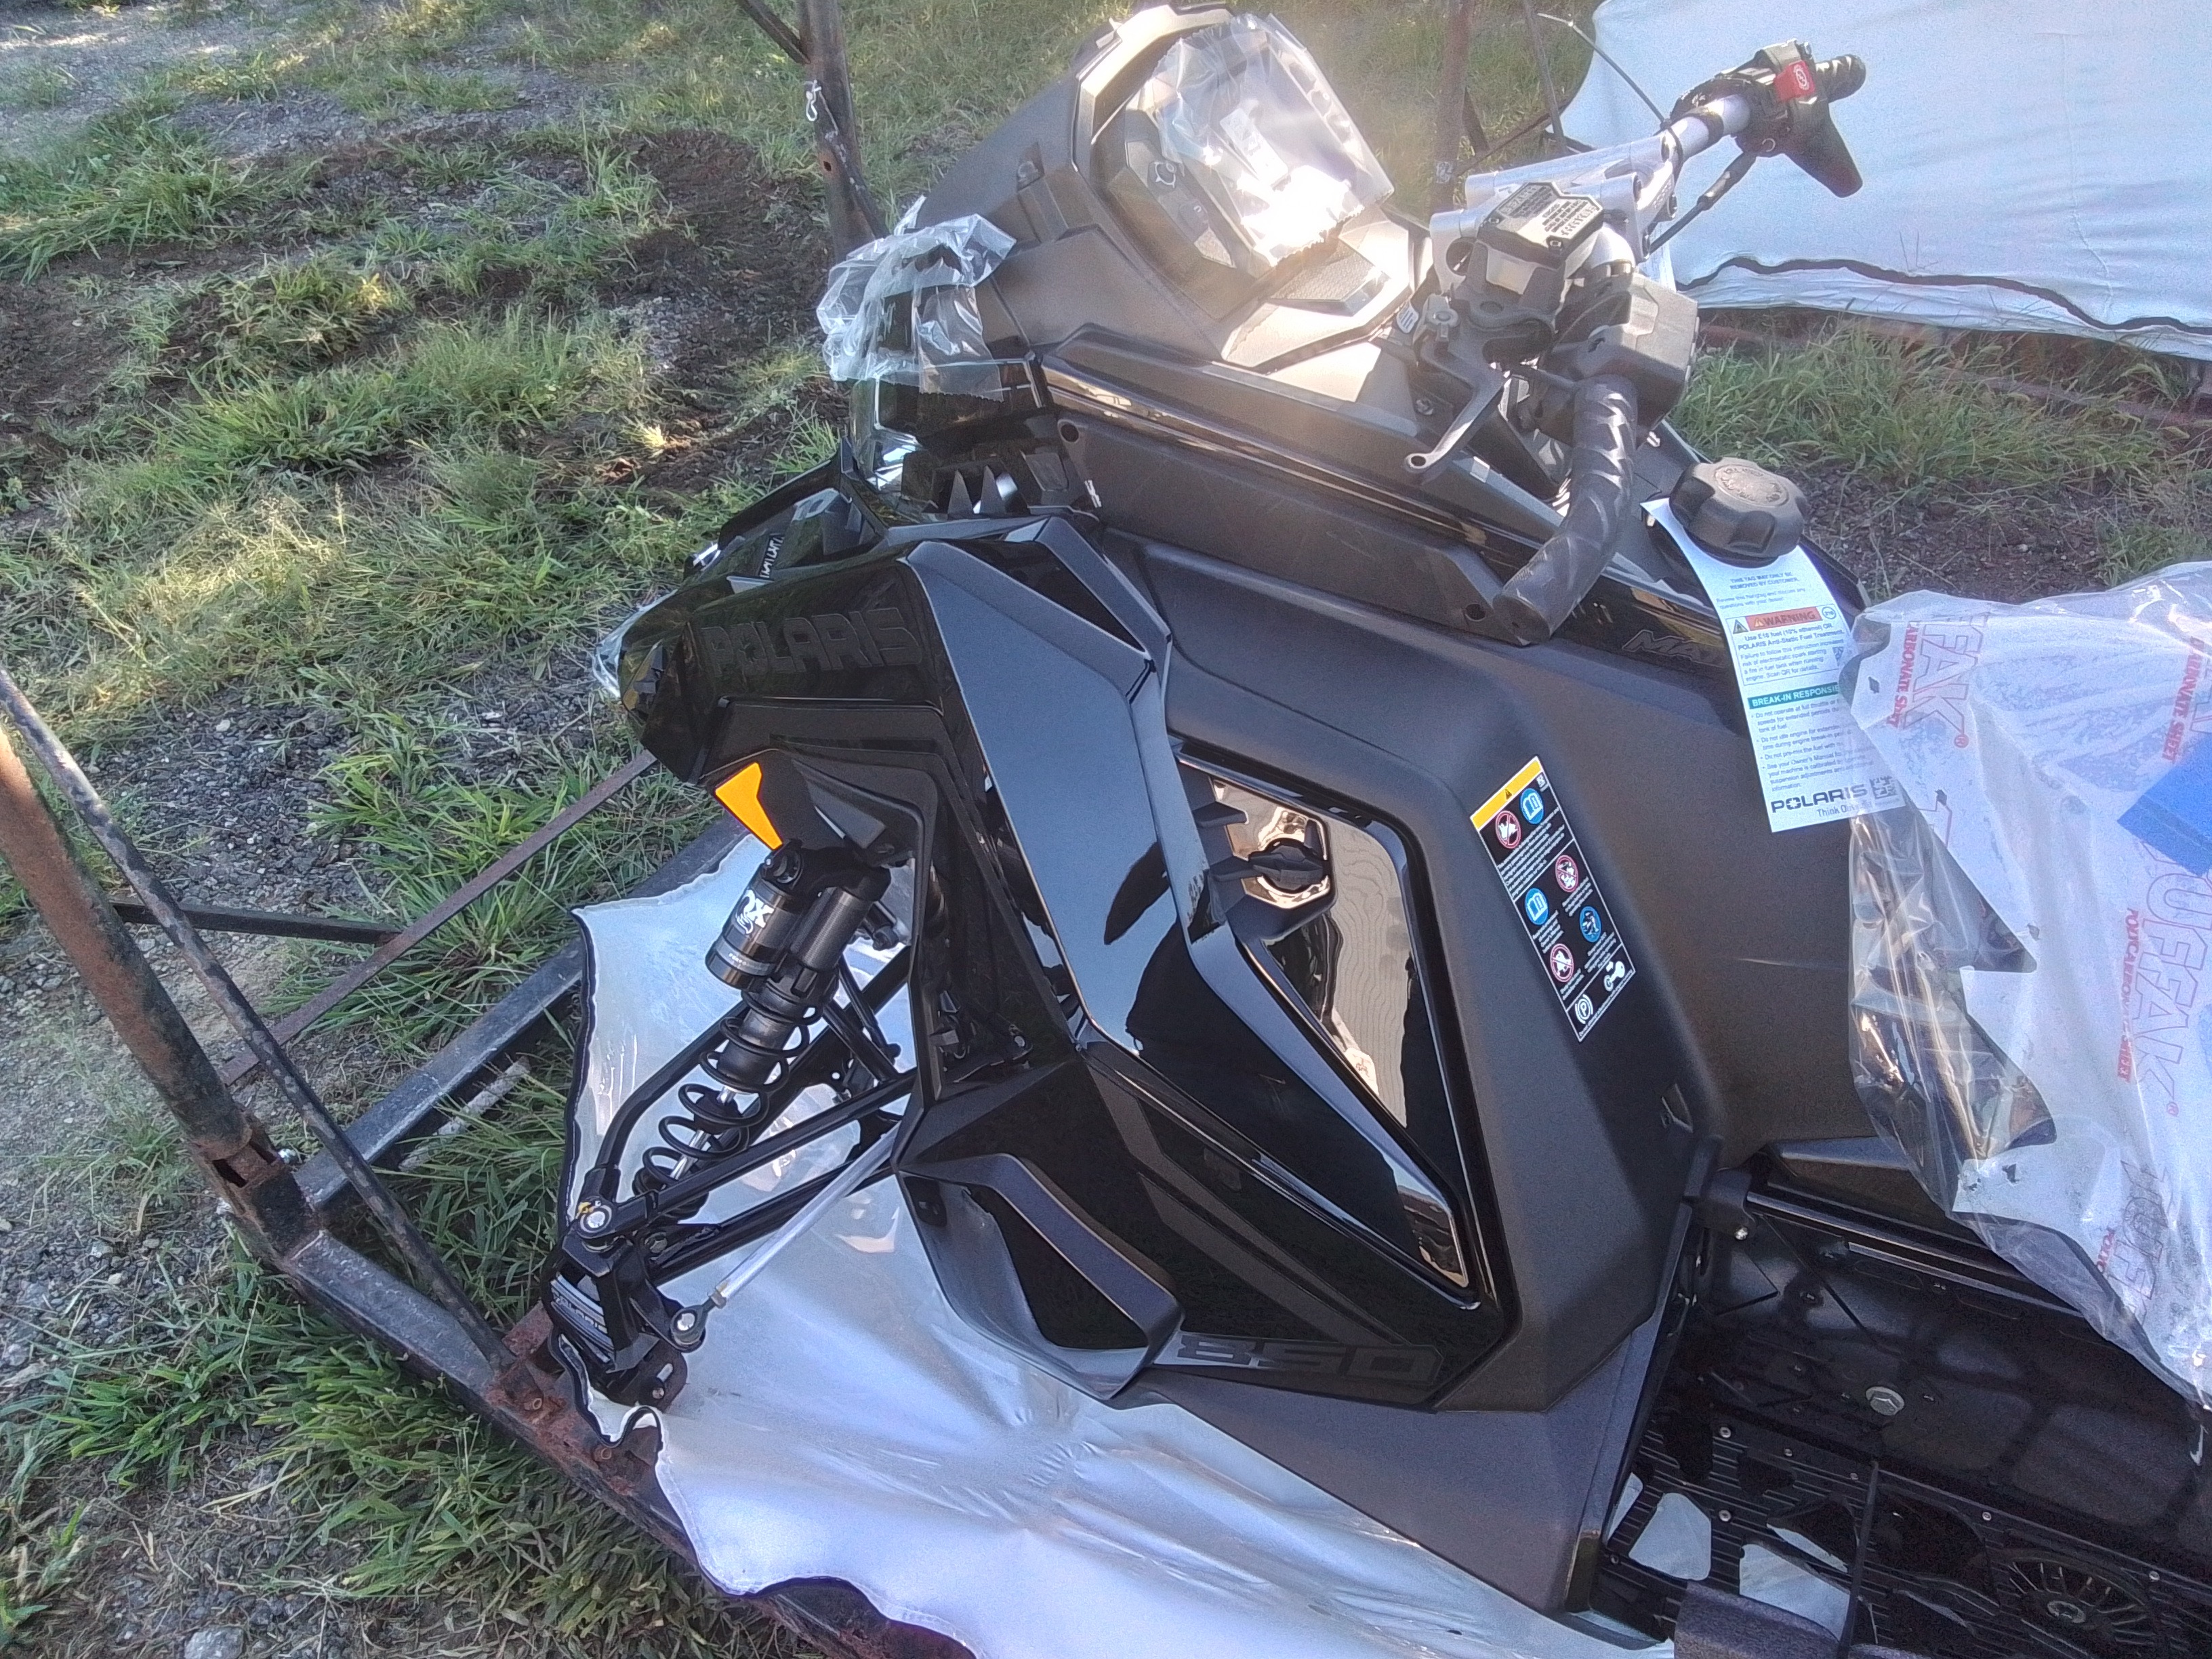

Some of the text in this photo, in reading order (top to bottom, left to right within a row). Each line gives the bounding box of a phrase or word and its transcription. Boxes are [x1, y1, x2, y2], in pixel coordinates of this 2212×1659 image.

[1763, 611, 1816, 626] WARNING
[700, 607, 922, 677] POLARIS
[1738, 641, 1767, 650] POLARIS
[1768, 637, 1799, 646] Anti-Static
[1760, 655, 1791, 664] electrostatic
[1804, 657, 1824, 665] running
[1752, 694, 1792, 707] BREAK-IN
[1774, 707, 1795, 716] operate
[1757, 718, 1776, 726] speeds
[1785, 712, 1810, 720] extended
[1790, 730, 1807, 738] engine
[1775, 741, 1791, 750] during
[1792, 737, 1810, 745] engine
[1811, 733, 1833, 741] break-in
[1791, 757, 1813, 765] Owner's
[1814, 753, 1834, 762] Manual
[1810, 760, 1836, 770] calibrated
[1770, 776, 1799, 784] suspension
[1801, 769, 1833, 779] adjustments
[1771, 784, 1868, 813] POLARIS
[1817, 808, 1840, 817] Think
[2134, 842, 2212, 1117] UFFAK®
[1177, 1335, 1442, 1385] 850
